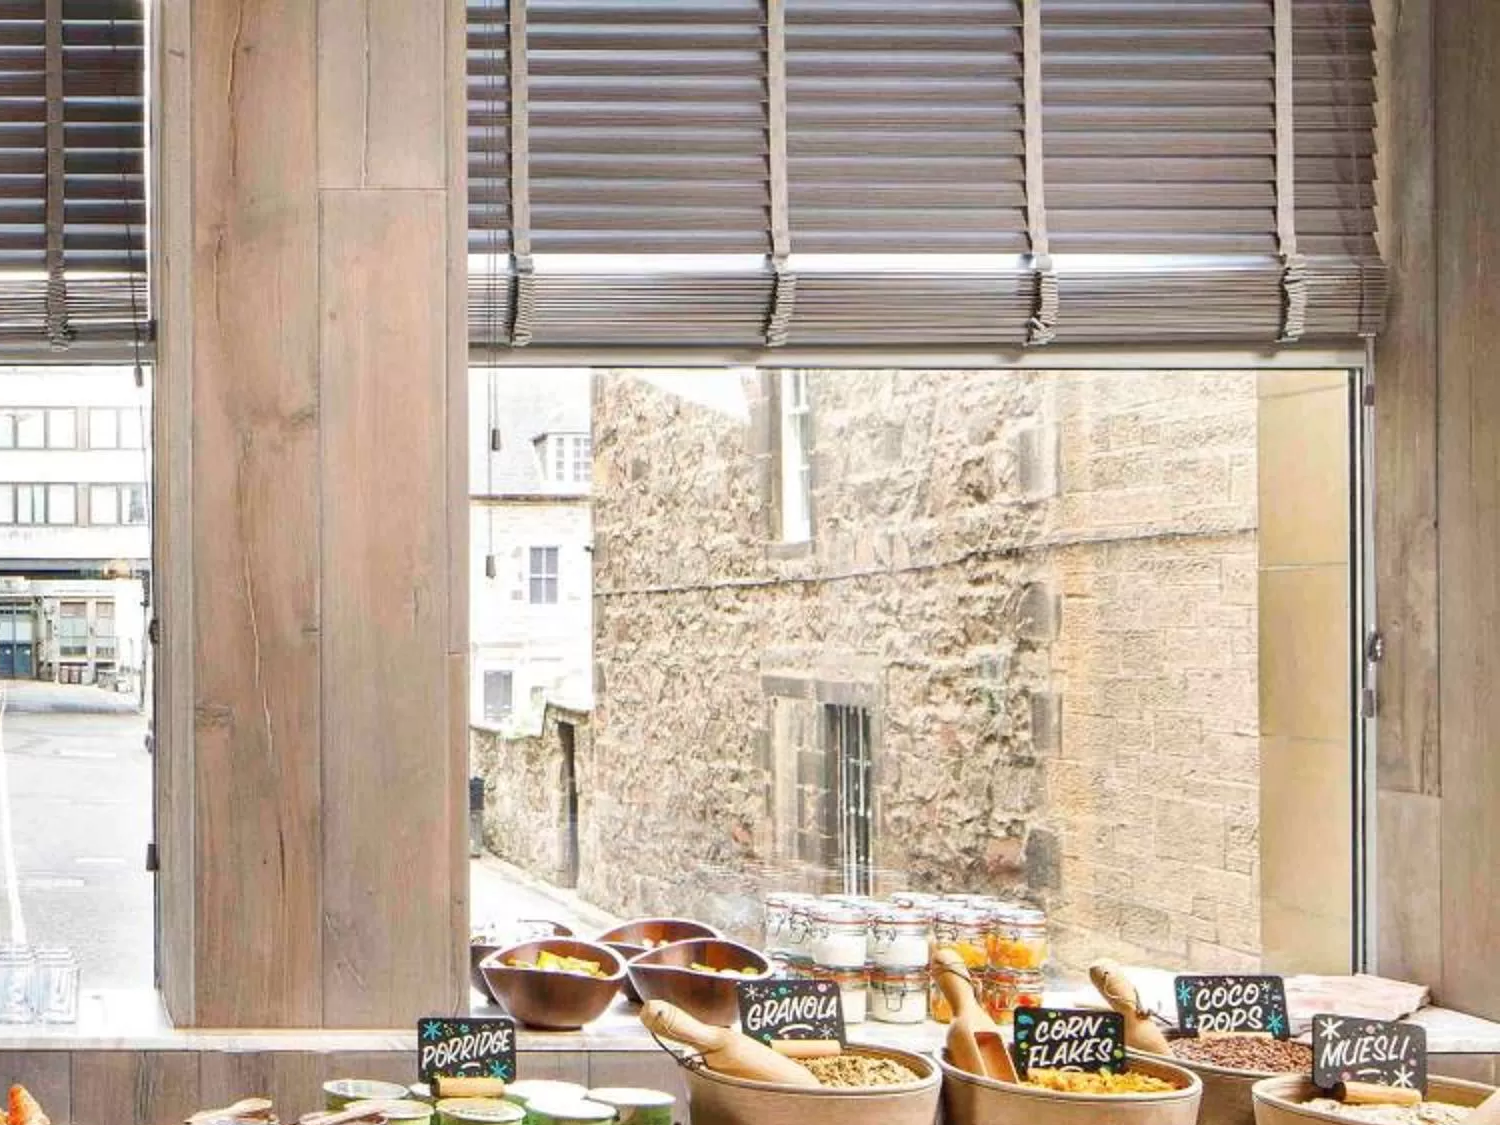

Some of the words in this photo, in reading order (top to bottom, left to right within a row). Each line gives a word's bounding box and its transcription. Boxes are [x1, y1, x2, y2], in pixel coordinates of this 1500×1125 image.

[1195, 983, 1260, 1011] COCO
[747, 995, 838, 1031] GRANOLA
[1034, 1015, 1104, 1042] CORN
[1197, 1006, 1263, 1033] POPS
[421, 1029, 512, 1070] PORRIDGE
[1028, 1037, 1113, 1068] FLAKES
[1320, 1035, 1410, 1069] MUESLI
